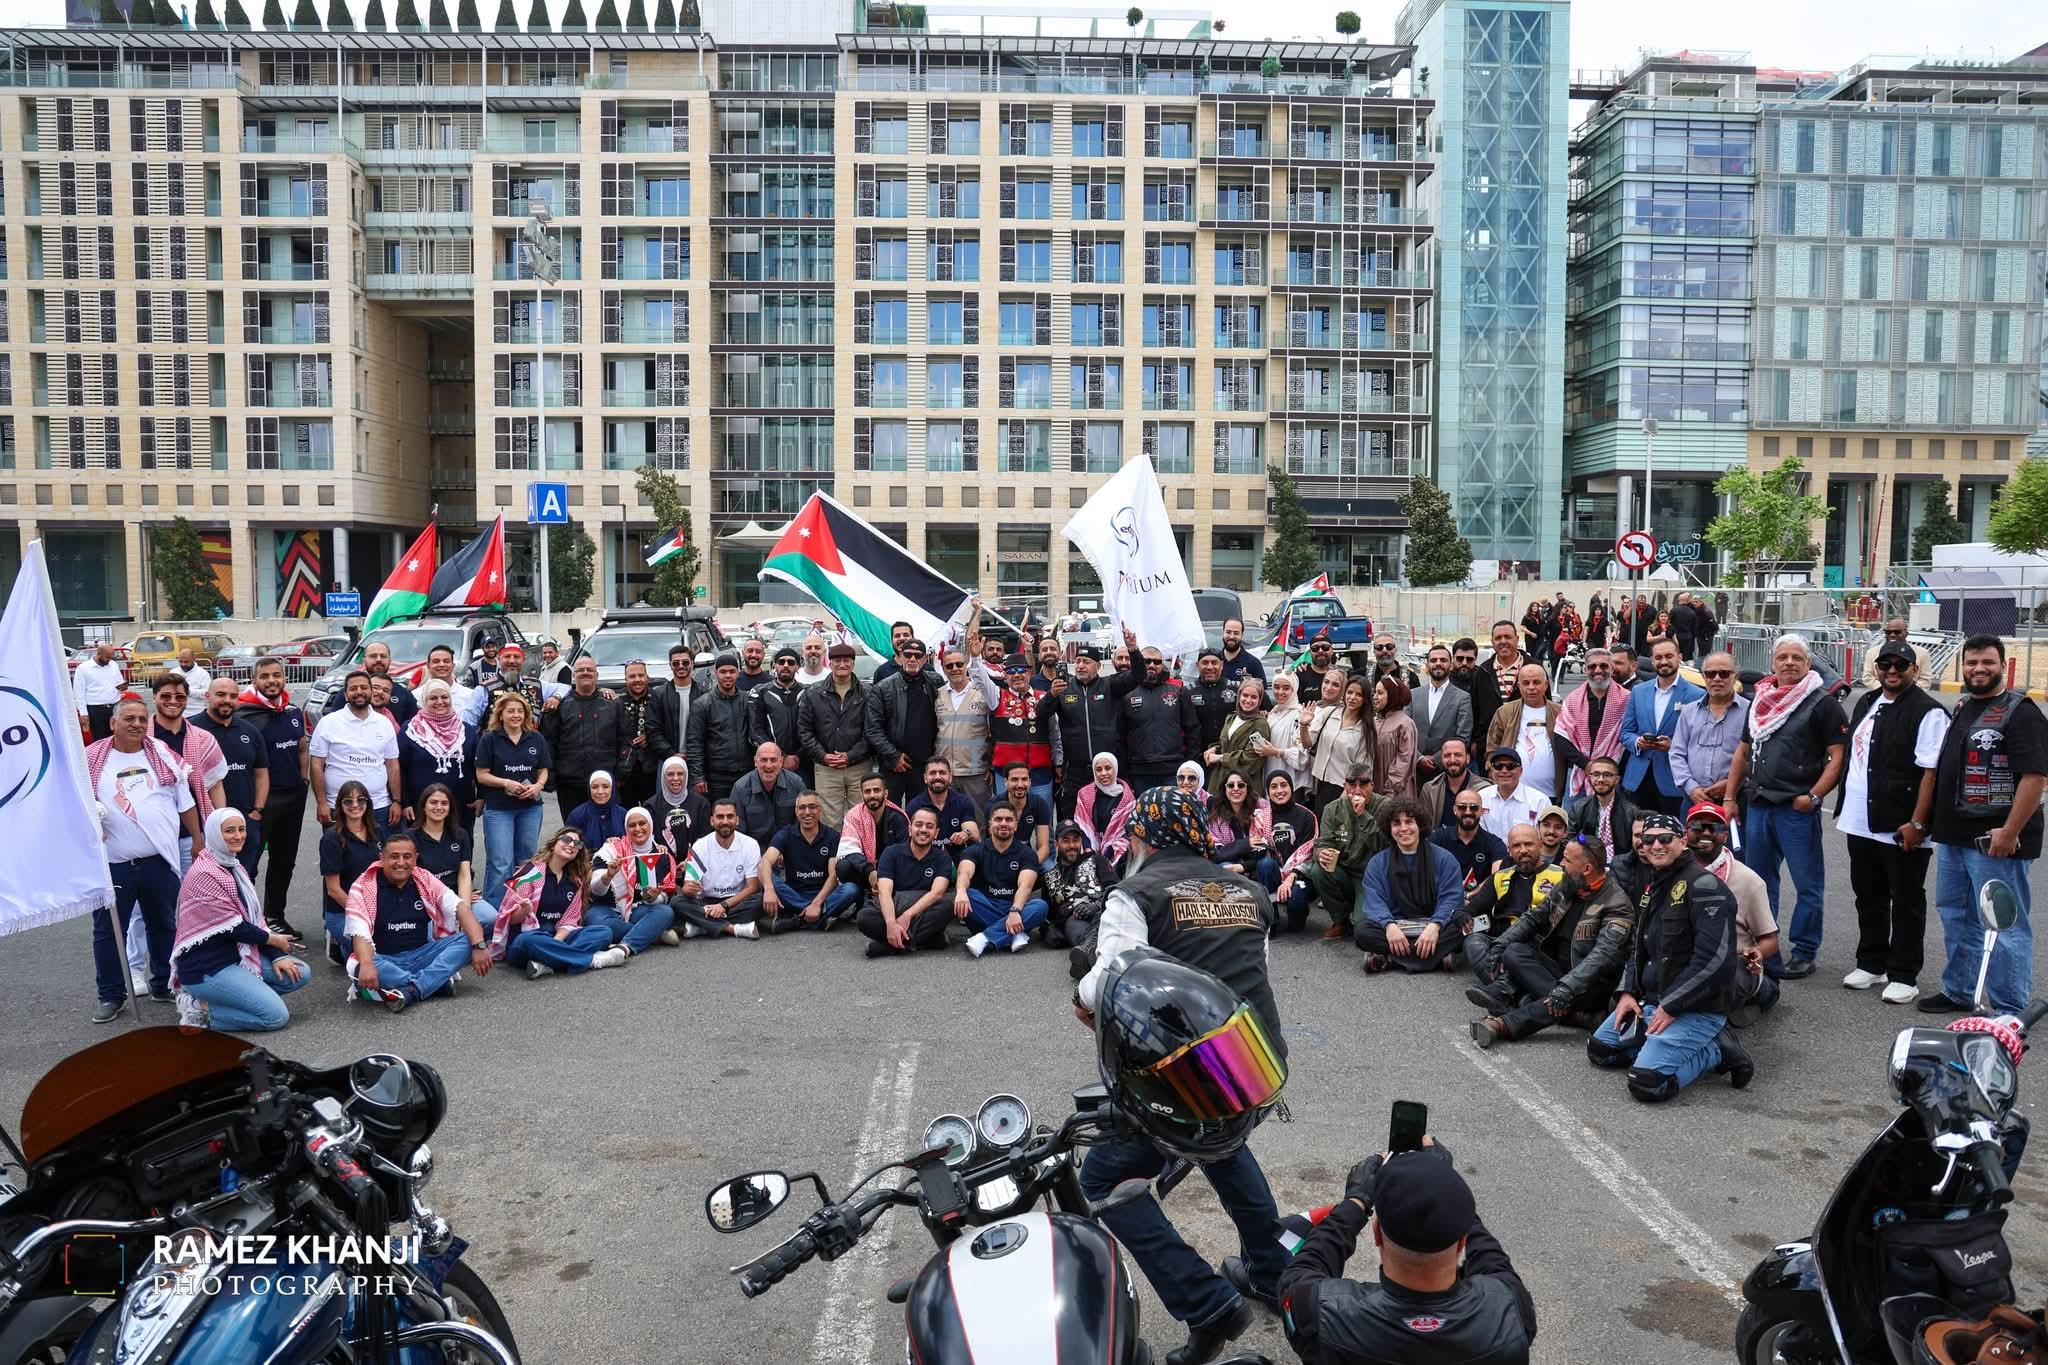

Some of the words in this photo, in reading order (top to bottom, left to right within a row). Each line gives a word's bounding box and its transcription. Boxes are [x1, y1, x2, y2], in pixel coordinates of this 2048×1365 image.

[542, 489, 562, 517] A
[1003, 552, 1042, 560] SAKAN
[505, 763, 533, 773] Together
[796, 869, 824, 879] Together
[387, 920, 416, 932] Together
[1150, 1102, 1174, 1114] EVO
[1954, 1249, 1997, 1270] Vespa
